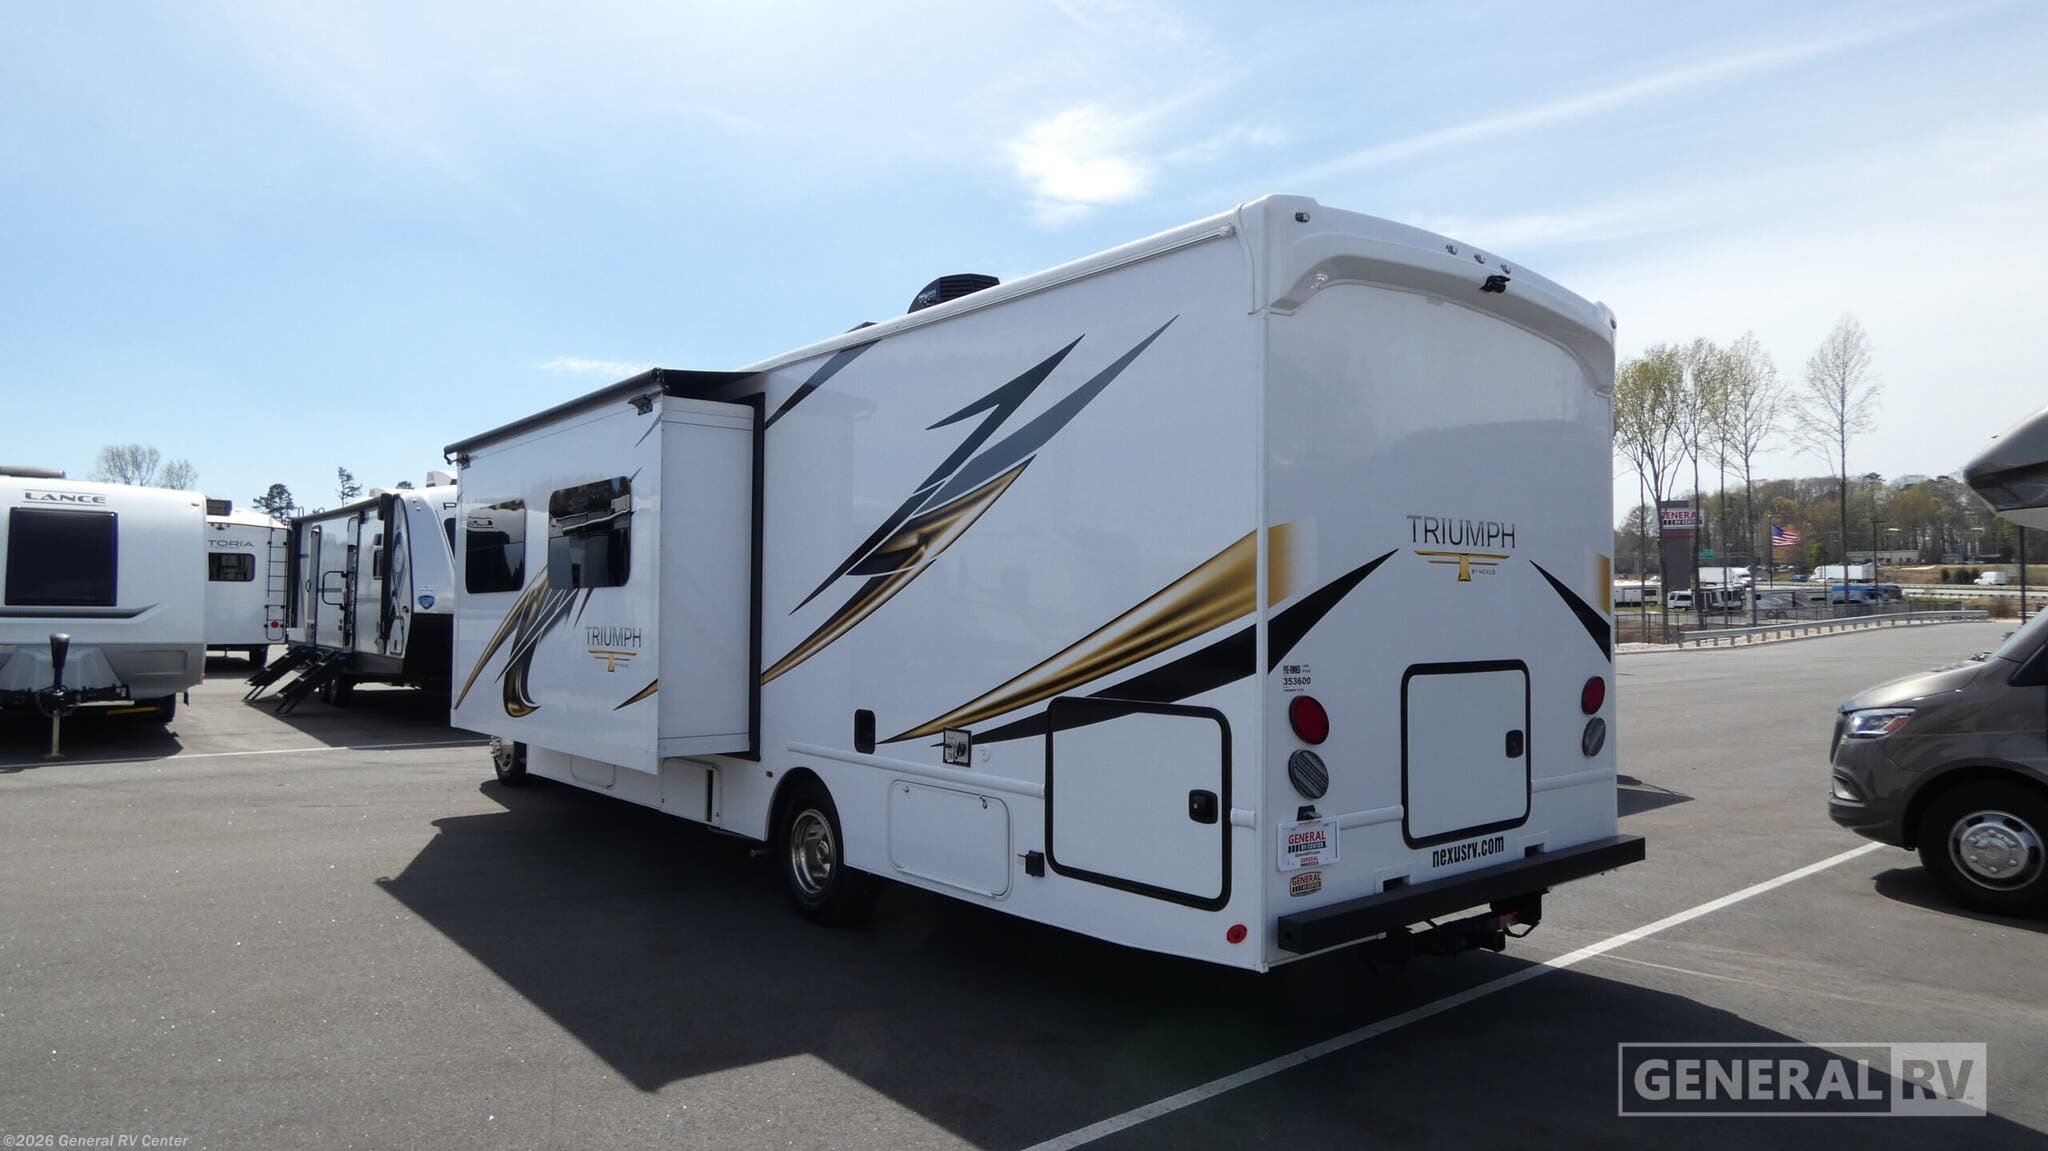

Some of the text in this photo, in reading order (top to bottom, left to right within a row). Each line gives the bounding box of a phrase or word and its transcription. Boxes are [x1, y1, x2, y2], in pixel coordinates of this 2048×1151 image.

[24, 492, 107, 504] LANCE
[1406, 515, 1515, 549] TRIUMPH
[207, 540, 255, 548] TORIA
[585, 626, 642, 648] TRIUMPH
[1283, 677, 1311, 685] 353600
[1288, 830, 1326, 845] GENERAL
[1432, 836, 1504, 868] nexusrv.com
[1292, 873, 1322, 886] GENERAL
